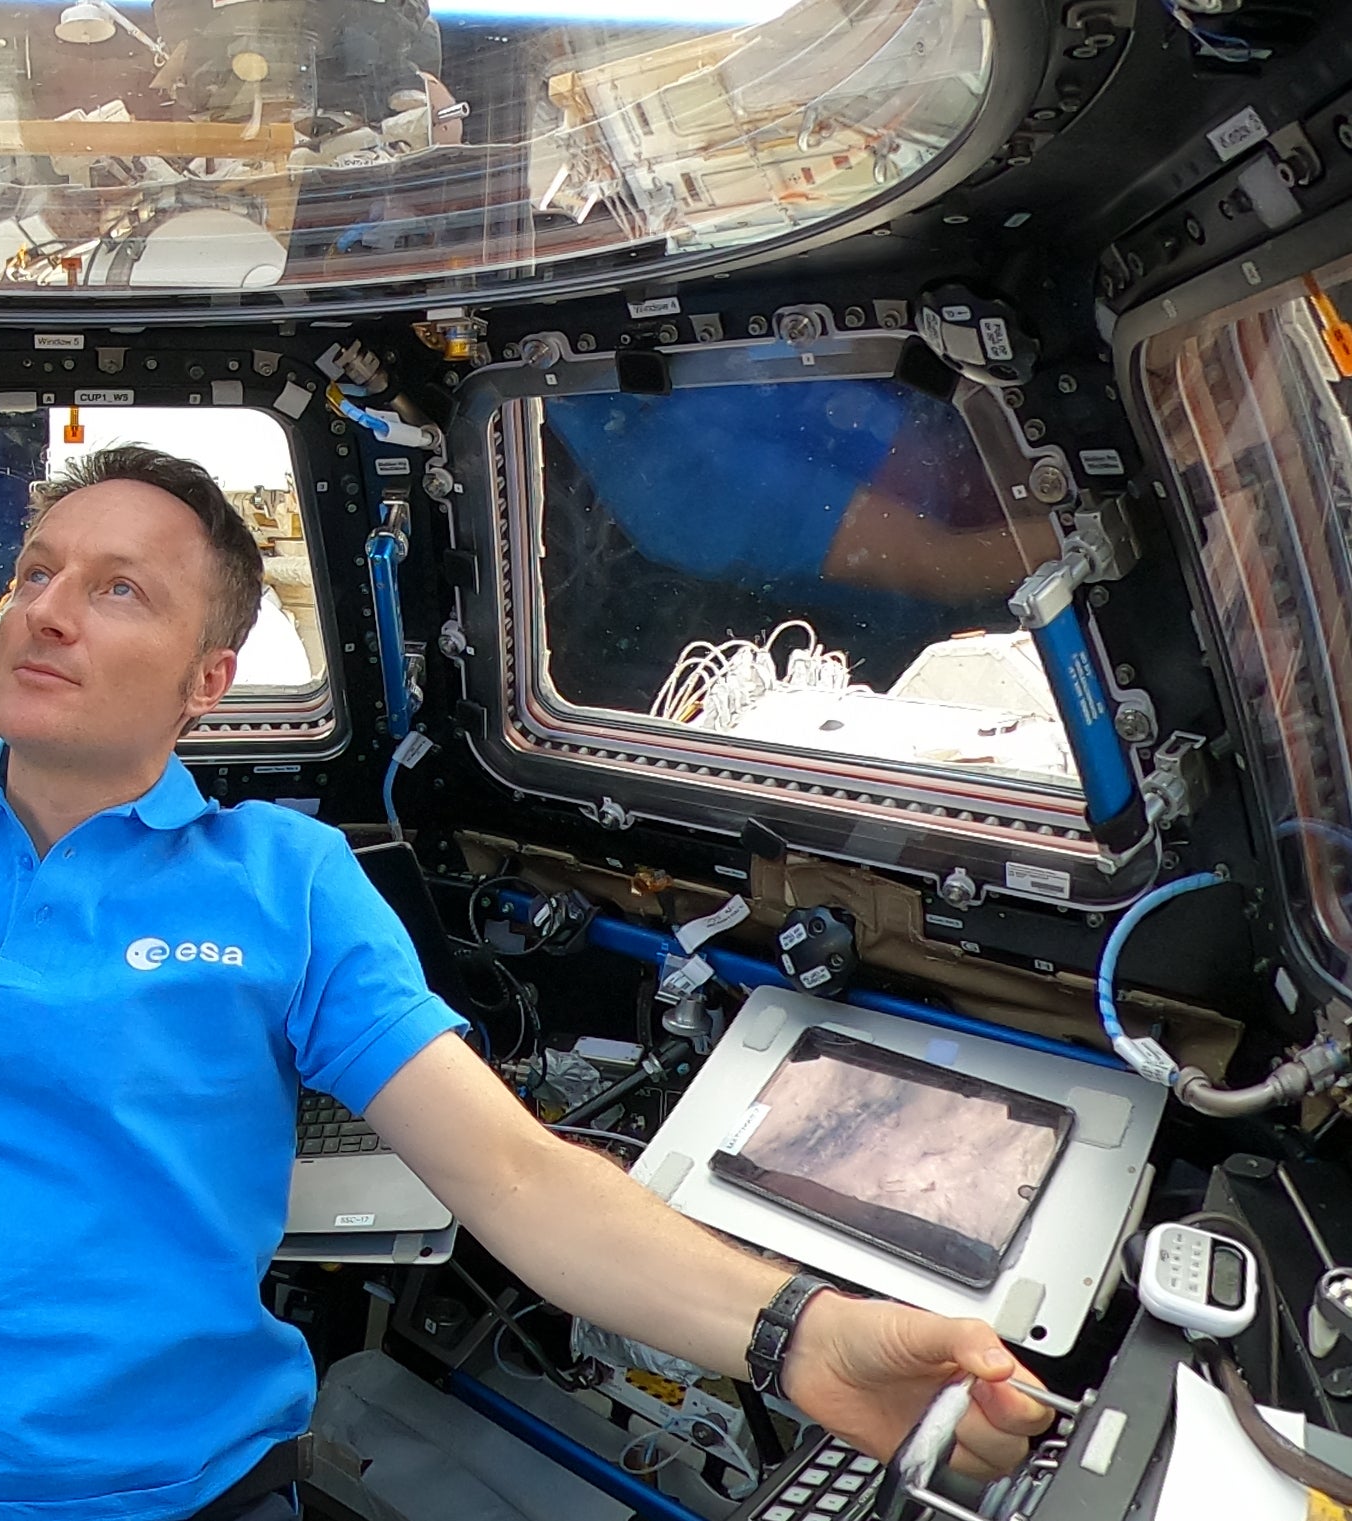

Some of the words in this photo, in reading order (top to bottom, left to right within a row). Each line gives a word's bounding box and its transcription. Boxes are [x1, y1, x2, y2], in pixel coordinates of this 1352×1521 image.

[37, 337, 71, 346] Window
[73, 337, 80, 346] 5
[79, 392, 129, 404] CUP1_W5
[174, 941, 244, 967] esa
